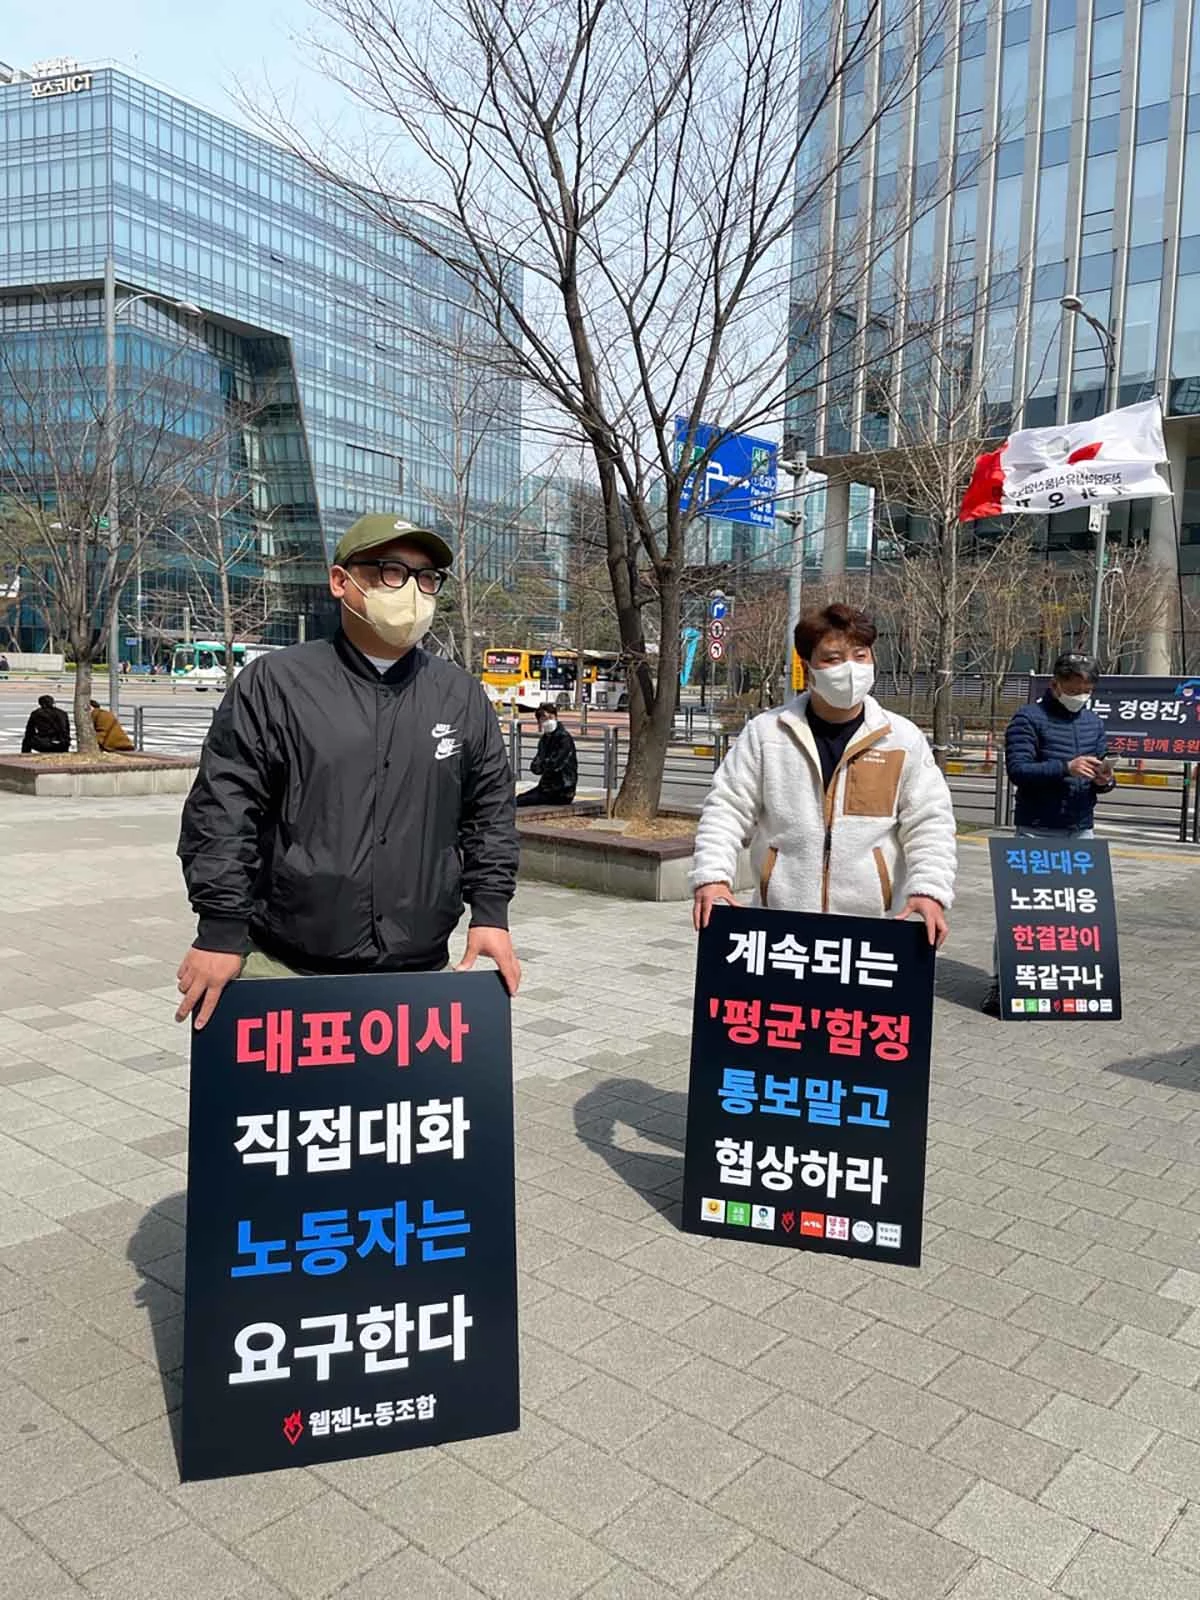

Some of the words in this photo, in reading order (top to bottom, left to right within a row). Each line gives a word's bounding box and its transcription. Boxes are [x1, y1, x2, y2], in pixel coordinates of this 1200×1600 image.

[1086, 699, 1112, 719] 는
[1118, 699, 1188, 724] 경영진,
[1006, 848, 1094, 875] 직원대우
[1010, 887, 1098, 913] 노조대응
[726, 930, 898, 988] 계속되는
[1012, 925, 1101, 952] 한결같이
[1015, 964, 1104, 991] 똑같구나
[235, 1001, 470, 1074] 대표이사
[709, 997, 911, 1062] '평균'함정
[717, 1067, 891, 1129] 통보말고
[233, 1096, 470, 1176] 직접대화
[715, 1137, 889, 1206] 협상하라
[230, 1199, 471, 1279] 노동자는
[228, 1294, 473, 1385] 요구한다
[308, 1394, 437, 1437] 웹젠노동조합
